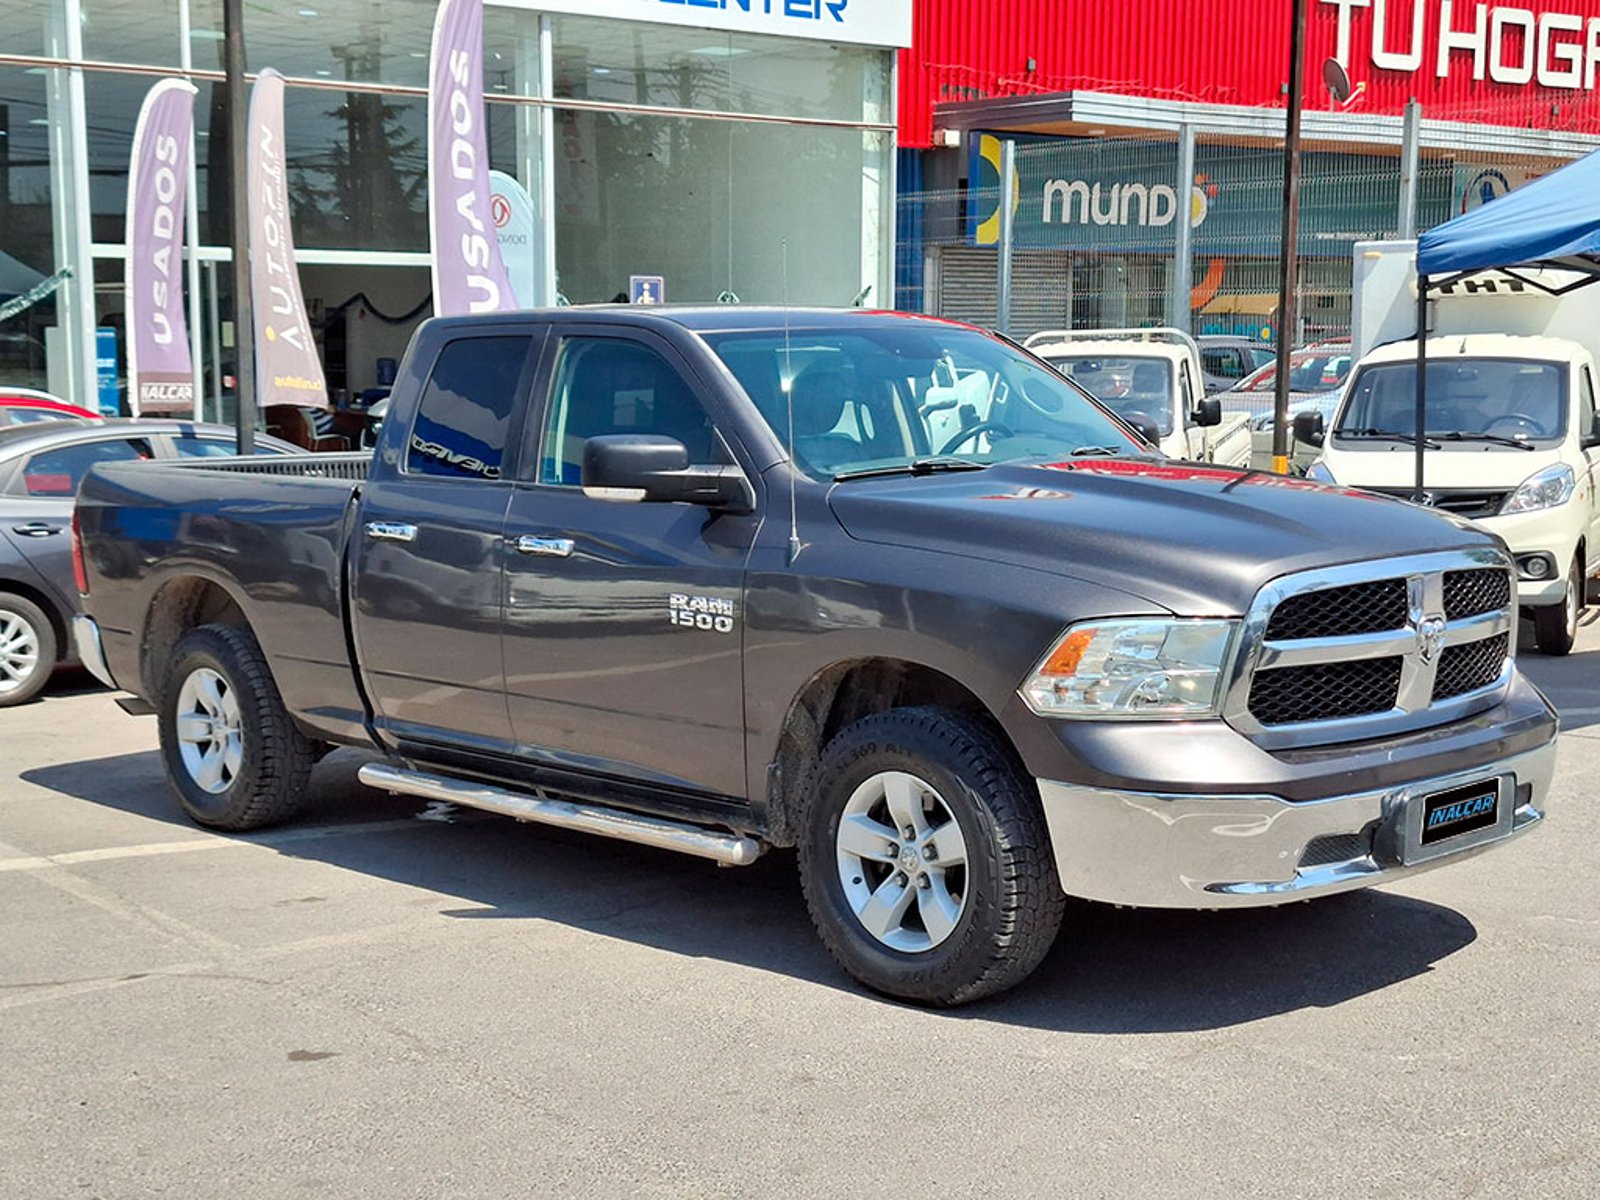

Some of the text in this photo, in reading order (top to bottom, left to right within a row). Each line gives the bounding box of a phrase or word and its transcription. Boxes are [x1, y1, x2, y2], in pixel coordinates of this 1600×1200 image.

[1319, 0, 1425, 71] TU
[449, 49, 501, 313] USADOS
[153, 133, 178, 345] USADOS
[669, 593, 734, 616] RAM
[669, 610, 735, 633] 1500
[1428, 794, 1495, 826] INALCAR
